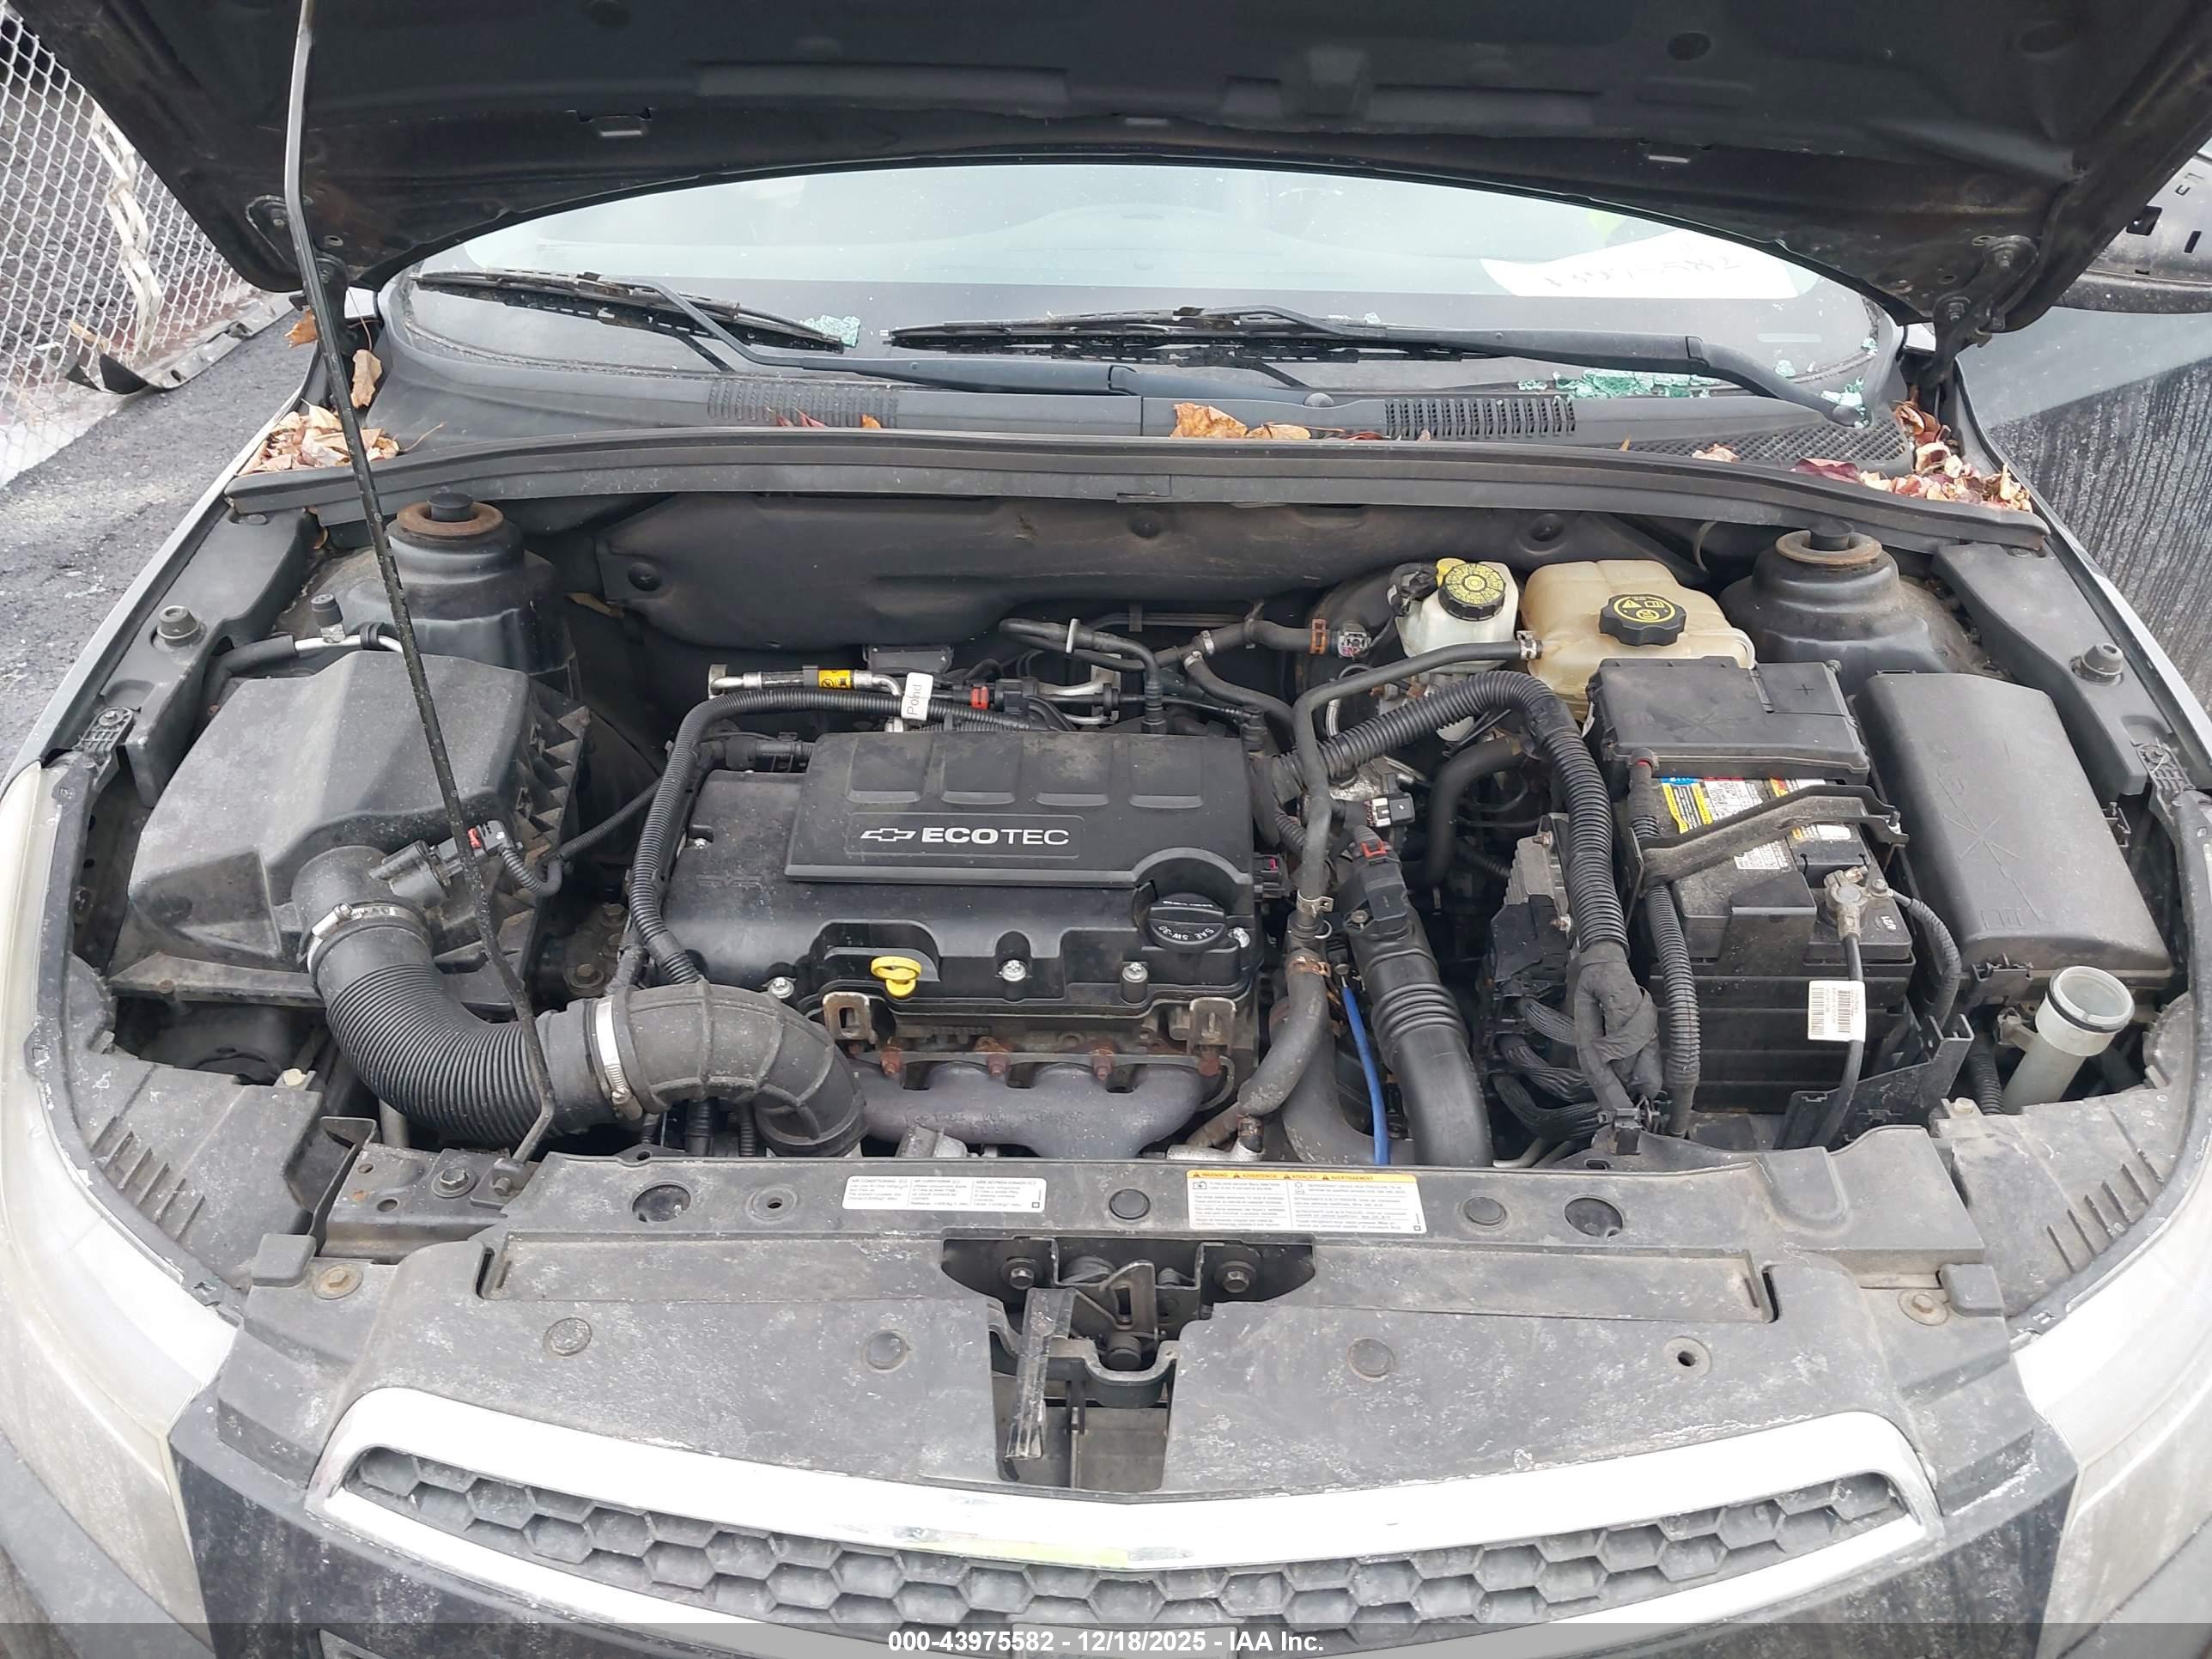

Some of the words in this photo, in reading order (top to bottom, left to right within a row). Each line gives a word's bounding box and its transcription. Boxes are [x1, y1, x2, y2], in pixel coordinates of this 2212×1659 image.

[921, 827, 1070, 846] ECOTEC
[1158, 926, 1189, 940] 5W-30
[1194, 927, 1215, 939] SAE
